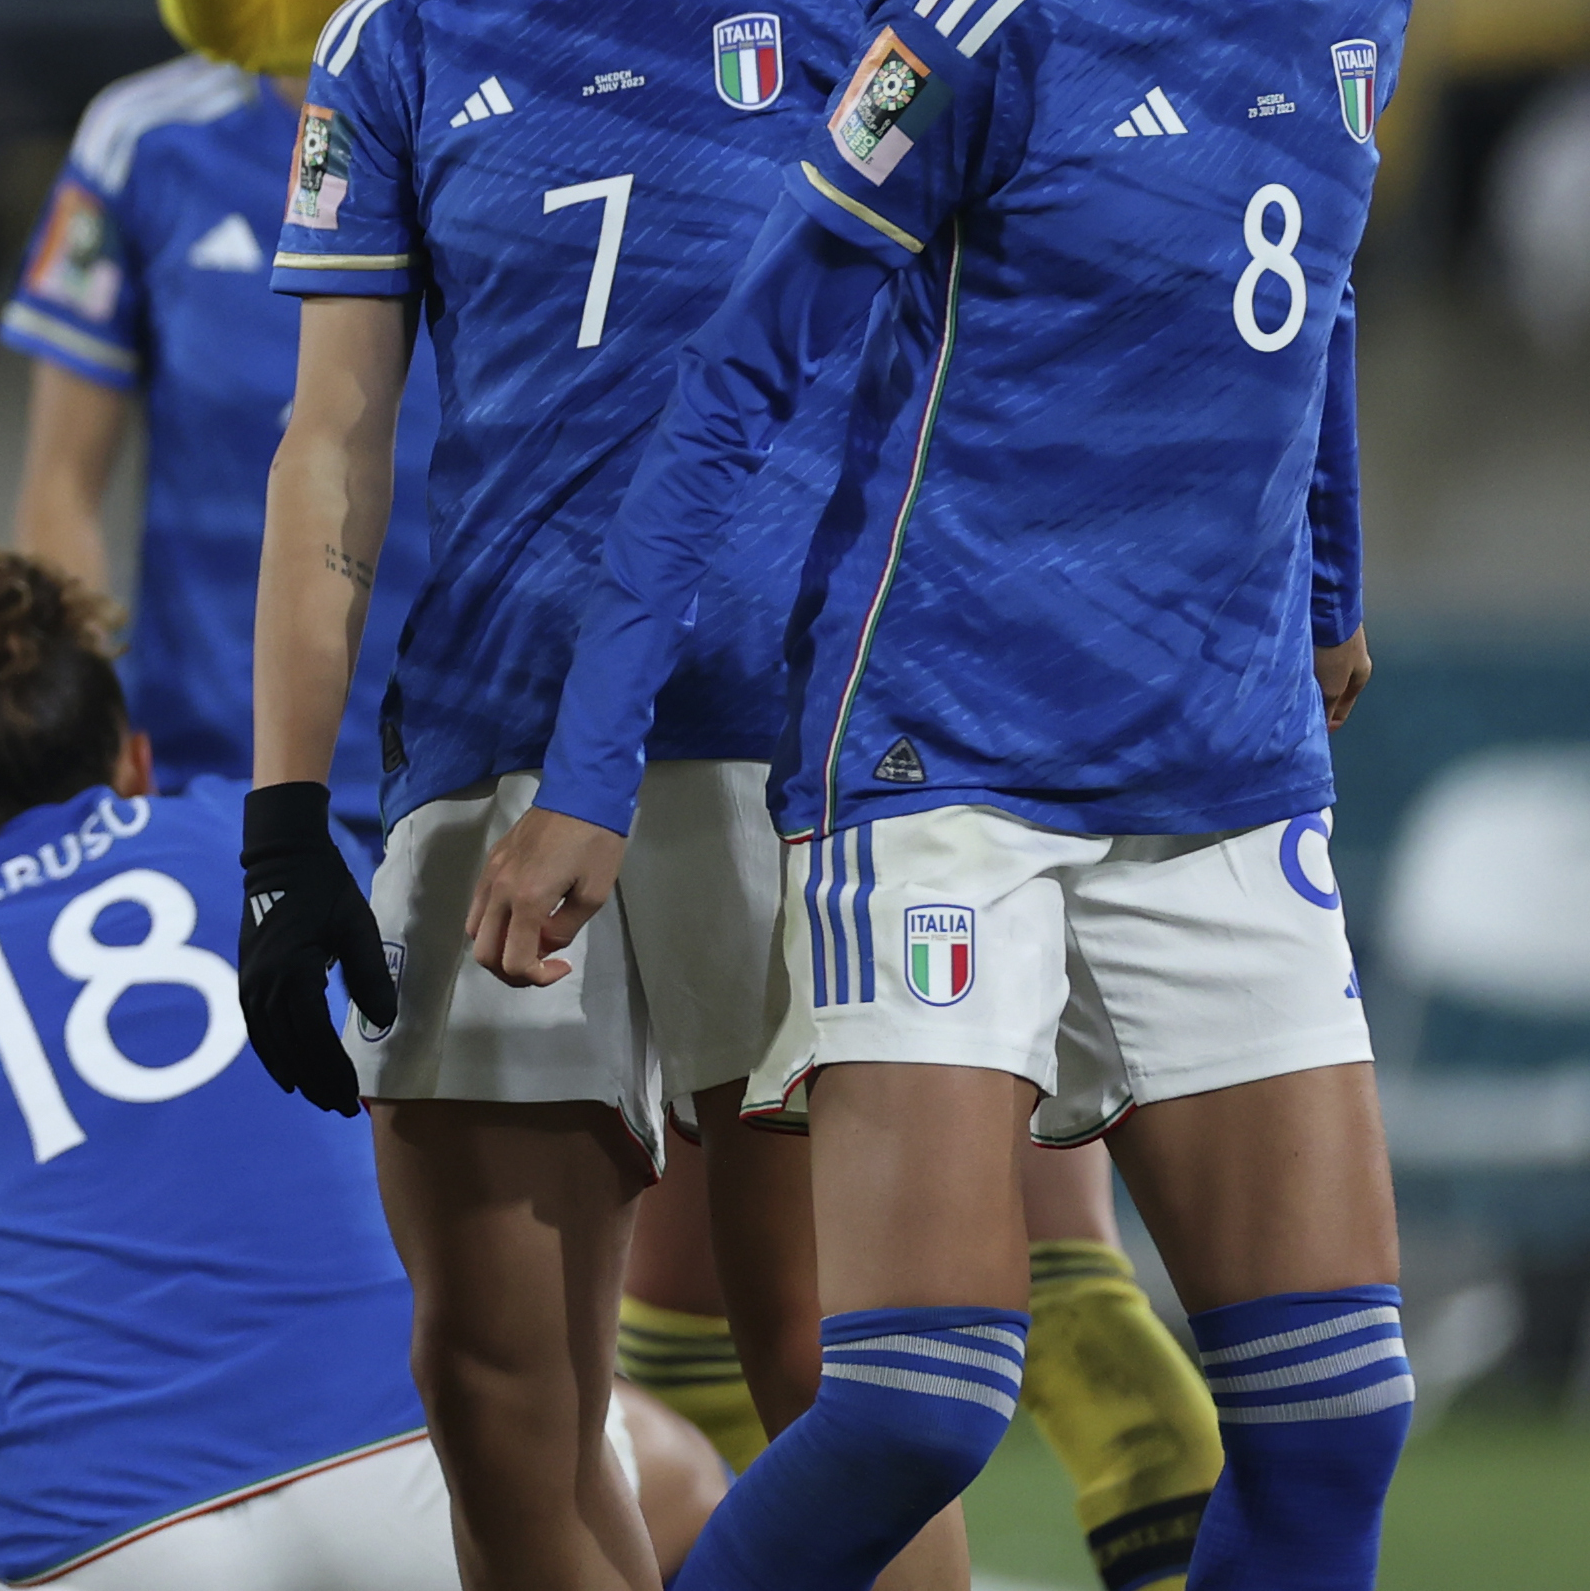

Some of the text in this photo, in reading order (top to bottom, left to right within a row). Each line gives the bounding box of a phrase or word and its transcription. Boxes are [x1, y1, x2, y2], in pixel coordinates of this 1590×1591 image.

[719, 20, 774, 46] ITALIA
[1337, 49, 1375, 70] ITALIA
[582, 75, 645, 97] 29 JULY 2023
[594, 70, 632, 85] SWEDEN
[543, 173, 634, 348] 7
[1233, 183, 1308, 353] 8
[911, 914, 968, 933] ITALIA
